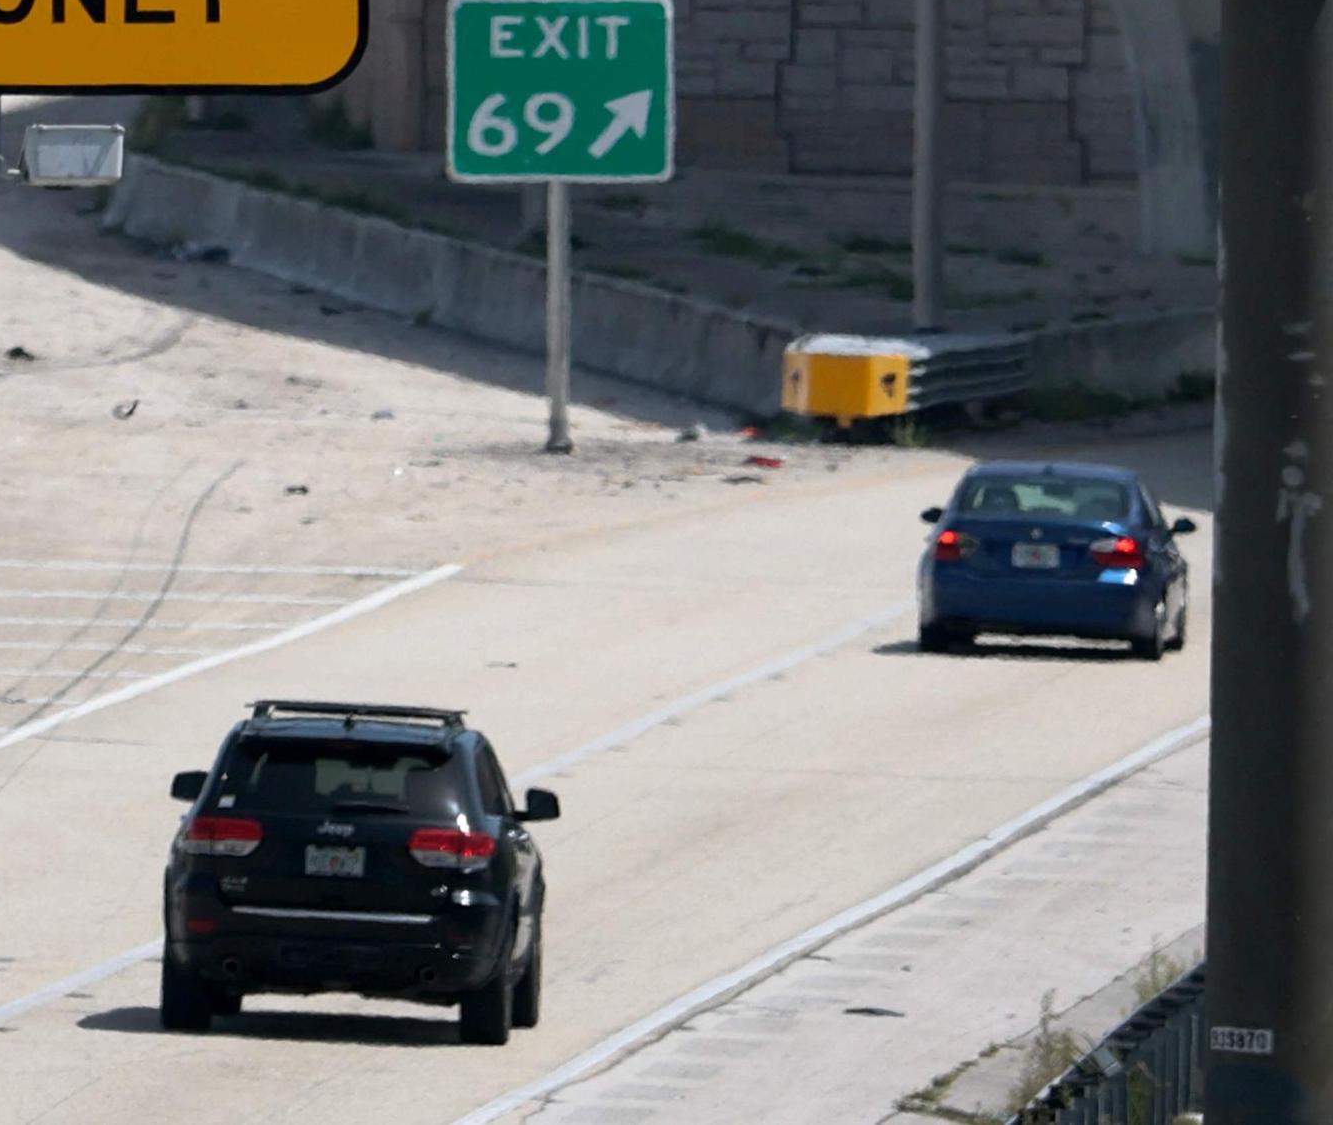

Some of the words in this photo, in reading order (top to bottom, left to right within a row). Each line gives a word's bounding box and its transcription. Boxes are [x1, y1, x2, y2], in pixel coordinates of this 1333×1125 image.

[490, 15, 629, 58] EXIT
[466, 92, 576, 157] 69
[317, 819, 356, 837] Jeep
